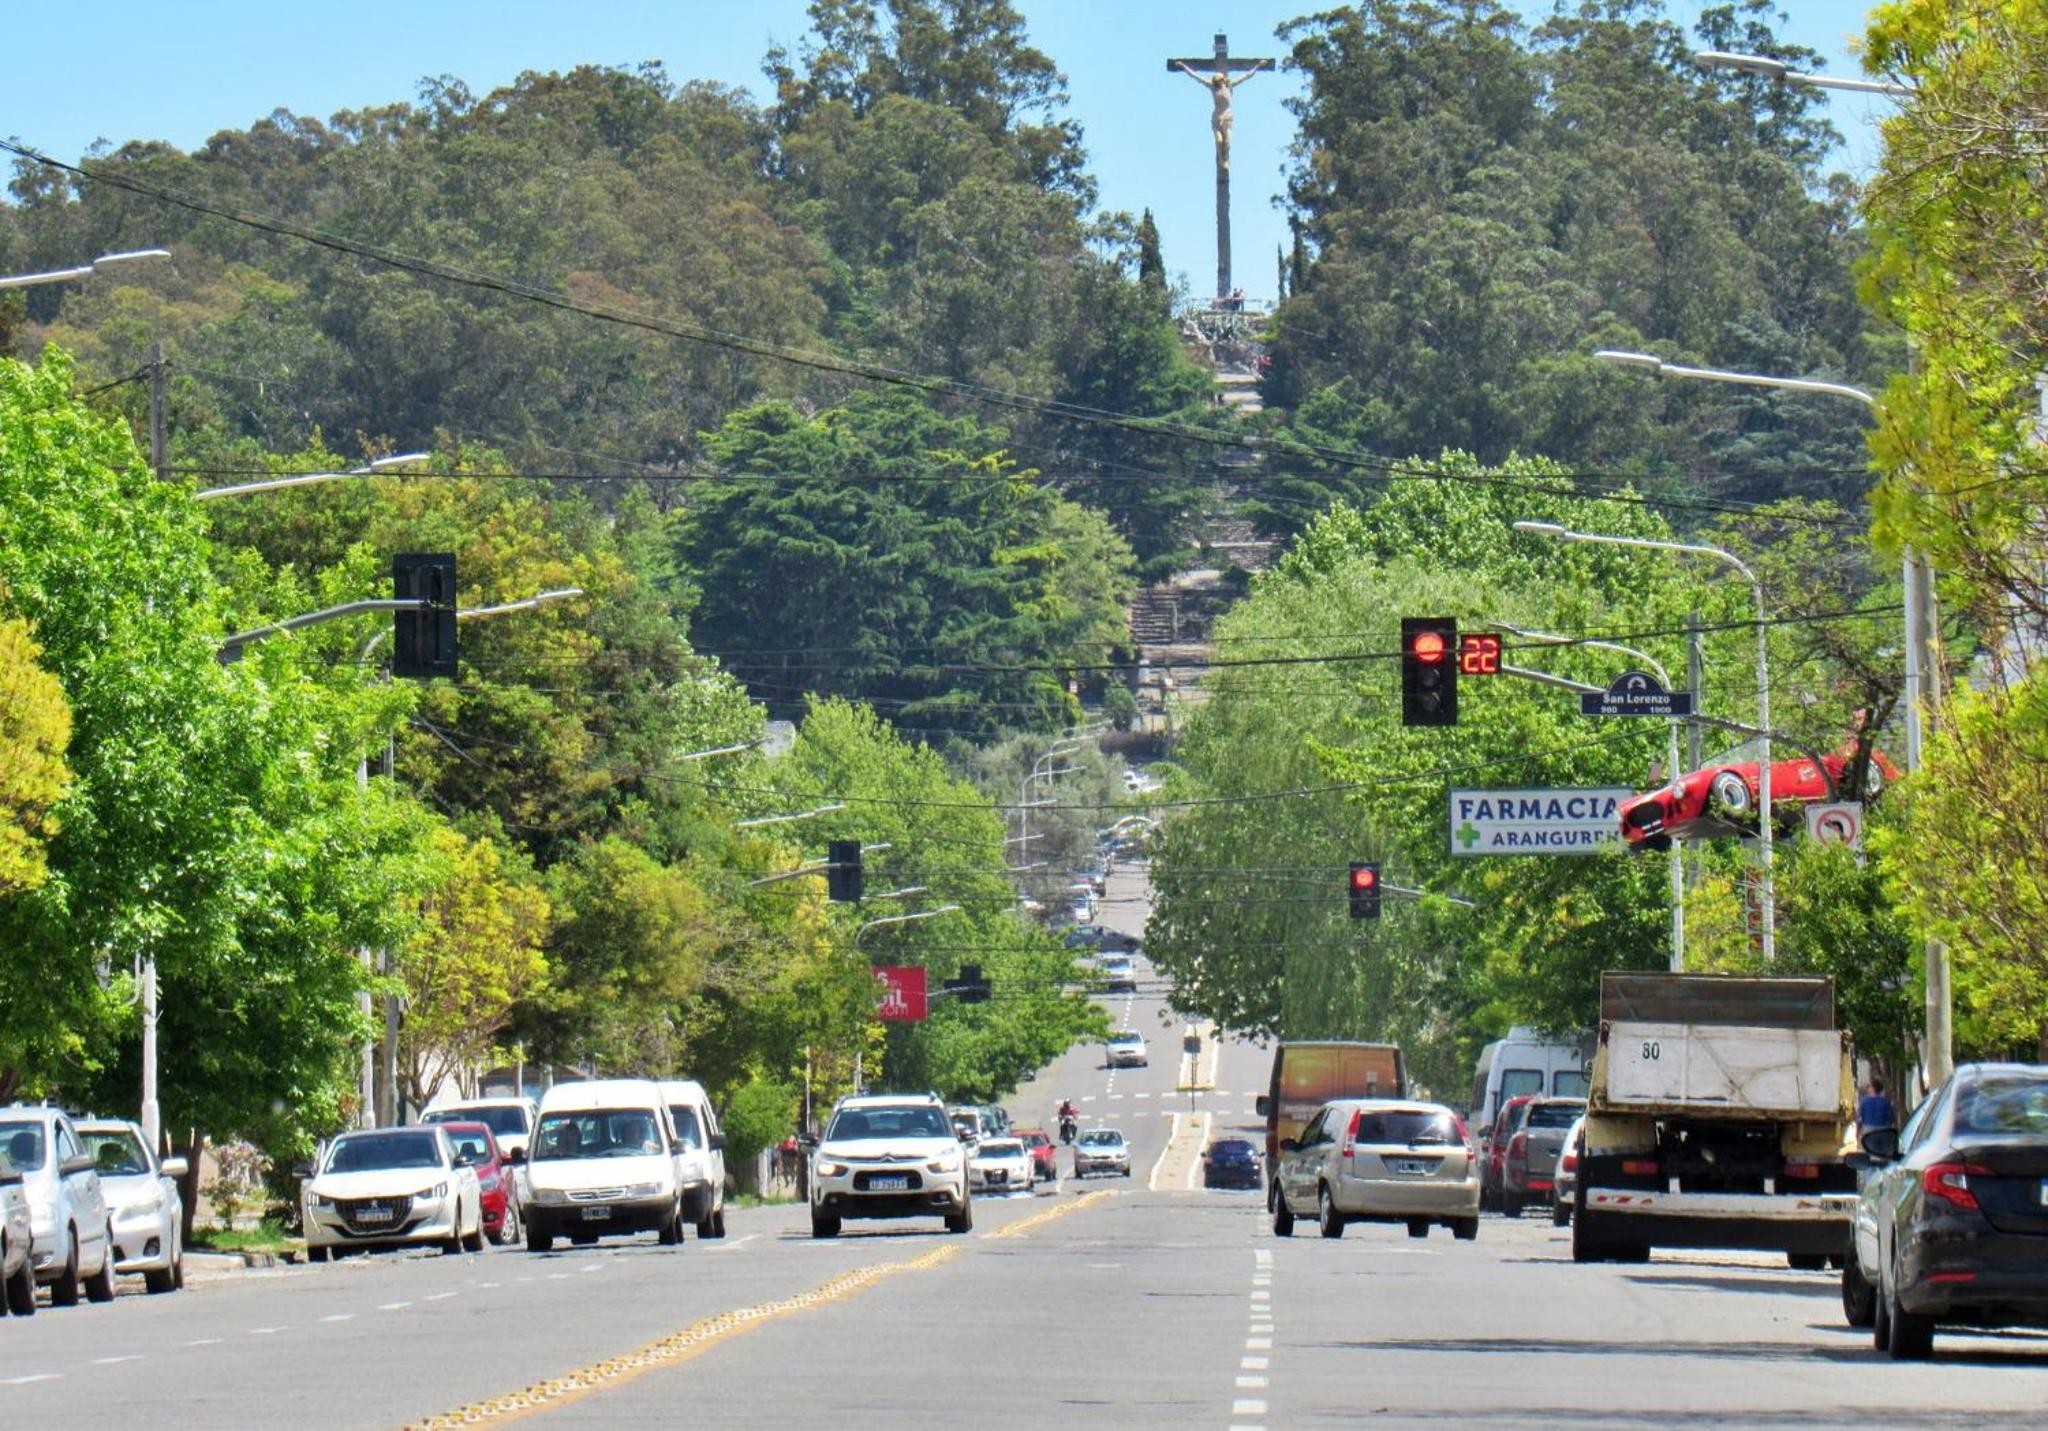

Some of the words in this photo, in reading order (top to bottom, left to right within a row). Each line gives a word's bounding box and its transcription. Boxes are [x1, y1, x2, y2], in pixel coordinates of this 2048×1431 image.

[1465, 639, 1497, 671] 22
[1603, 693, 1624, 704] San
[1627, 693, 1671, 704] Lorenzo
[1458, 796, 1617, 821] FARMACIA
[1642, 1042, 1660, 1060] 80
